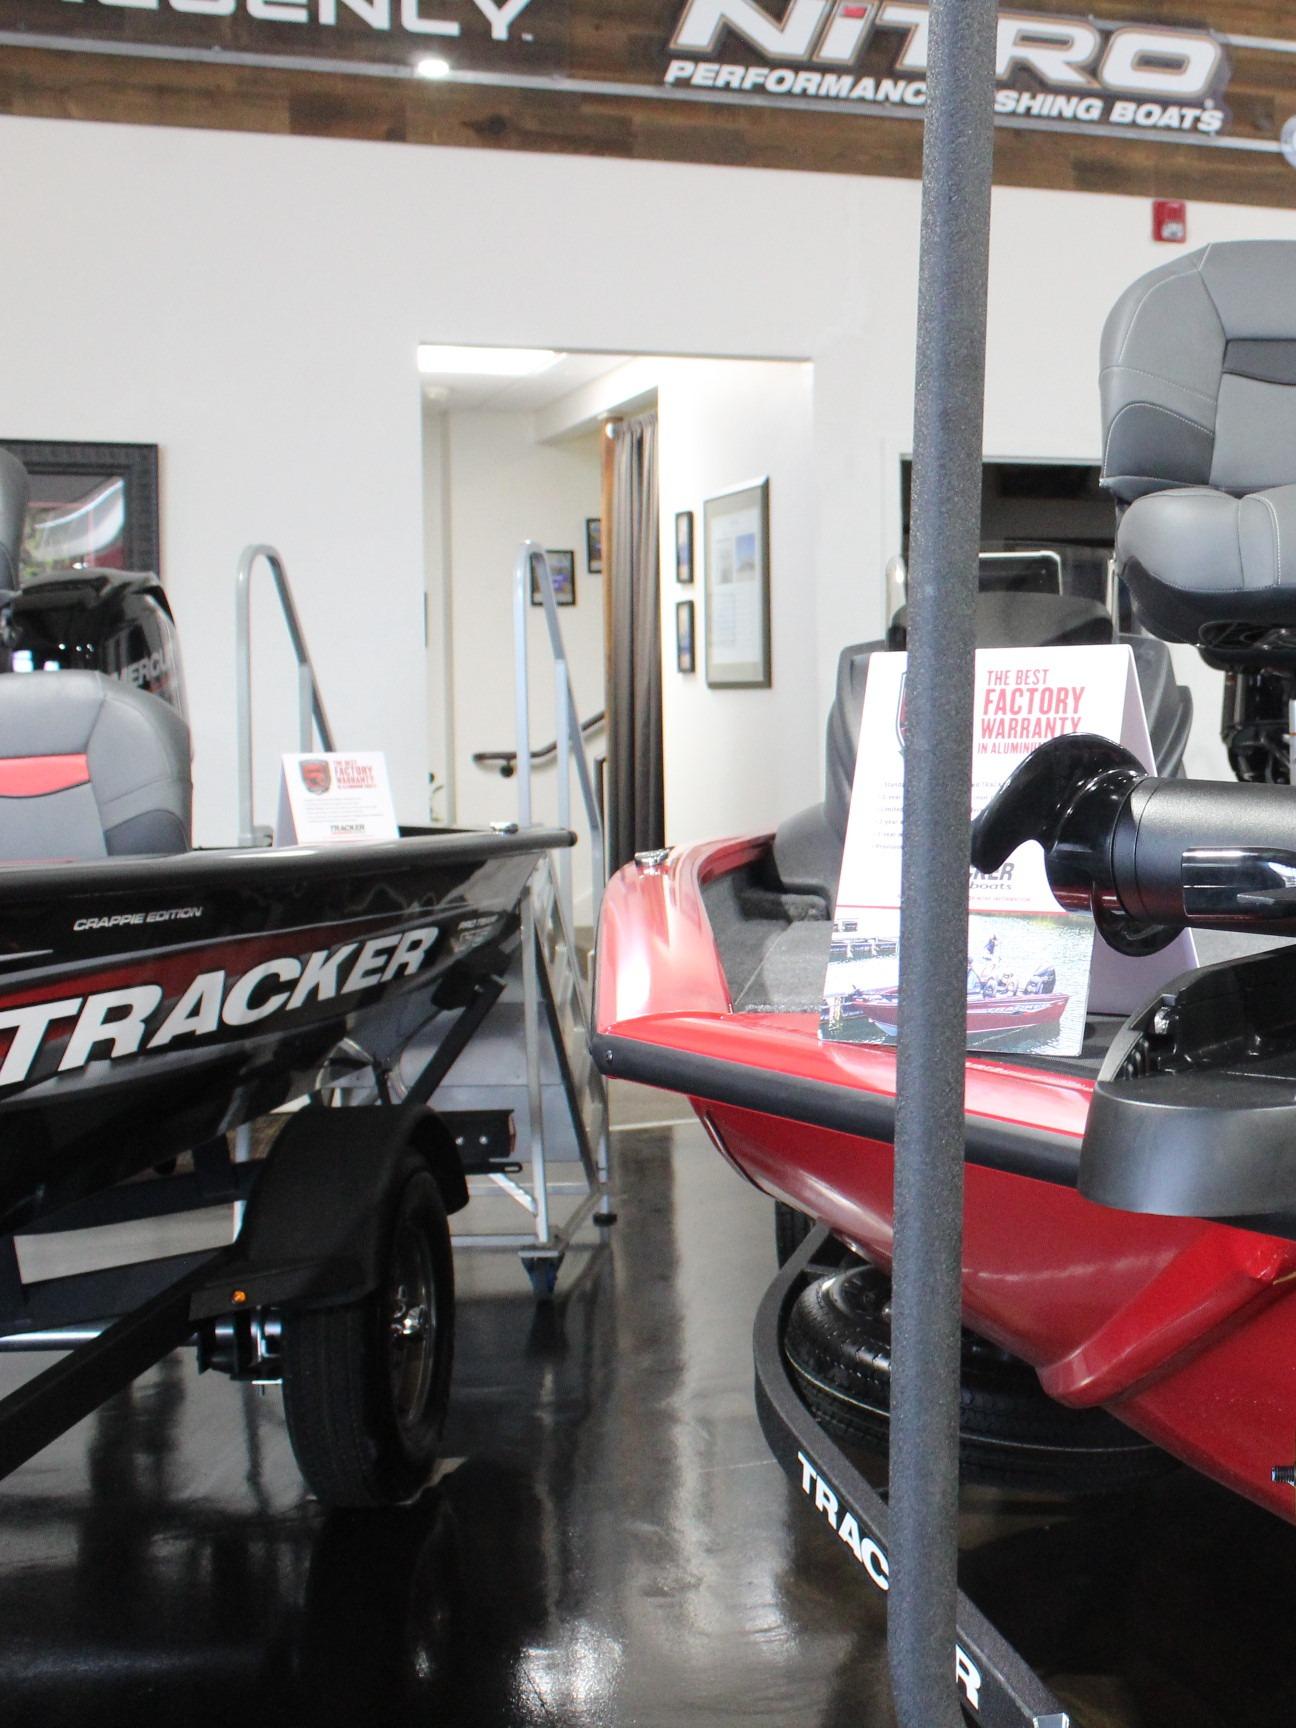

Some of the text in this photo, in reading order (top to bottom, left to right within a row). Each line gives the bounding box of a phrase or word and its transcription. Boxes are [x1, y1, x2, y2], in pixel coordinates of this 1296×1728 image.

[664, 60, 928, 106] PERFORMANC
[1108, 101, 1224, 134] BOATS
[986, 669, 1050, 686] THE BEST
[983, 686, 1085, 715] FACTORY
[981, 716, 1082, 739] WARRANTY
[977, 742, 988, 754] IN
[73, 906, 203, 931] CRAPPIE EDITION
[0, 927, 439, 1085] TRACKER
